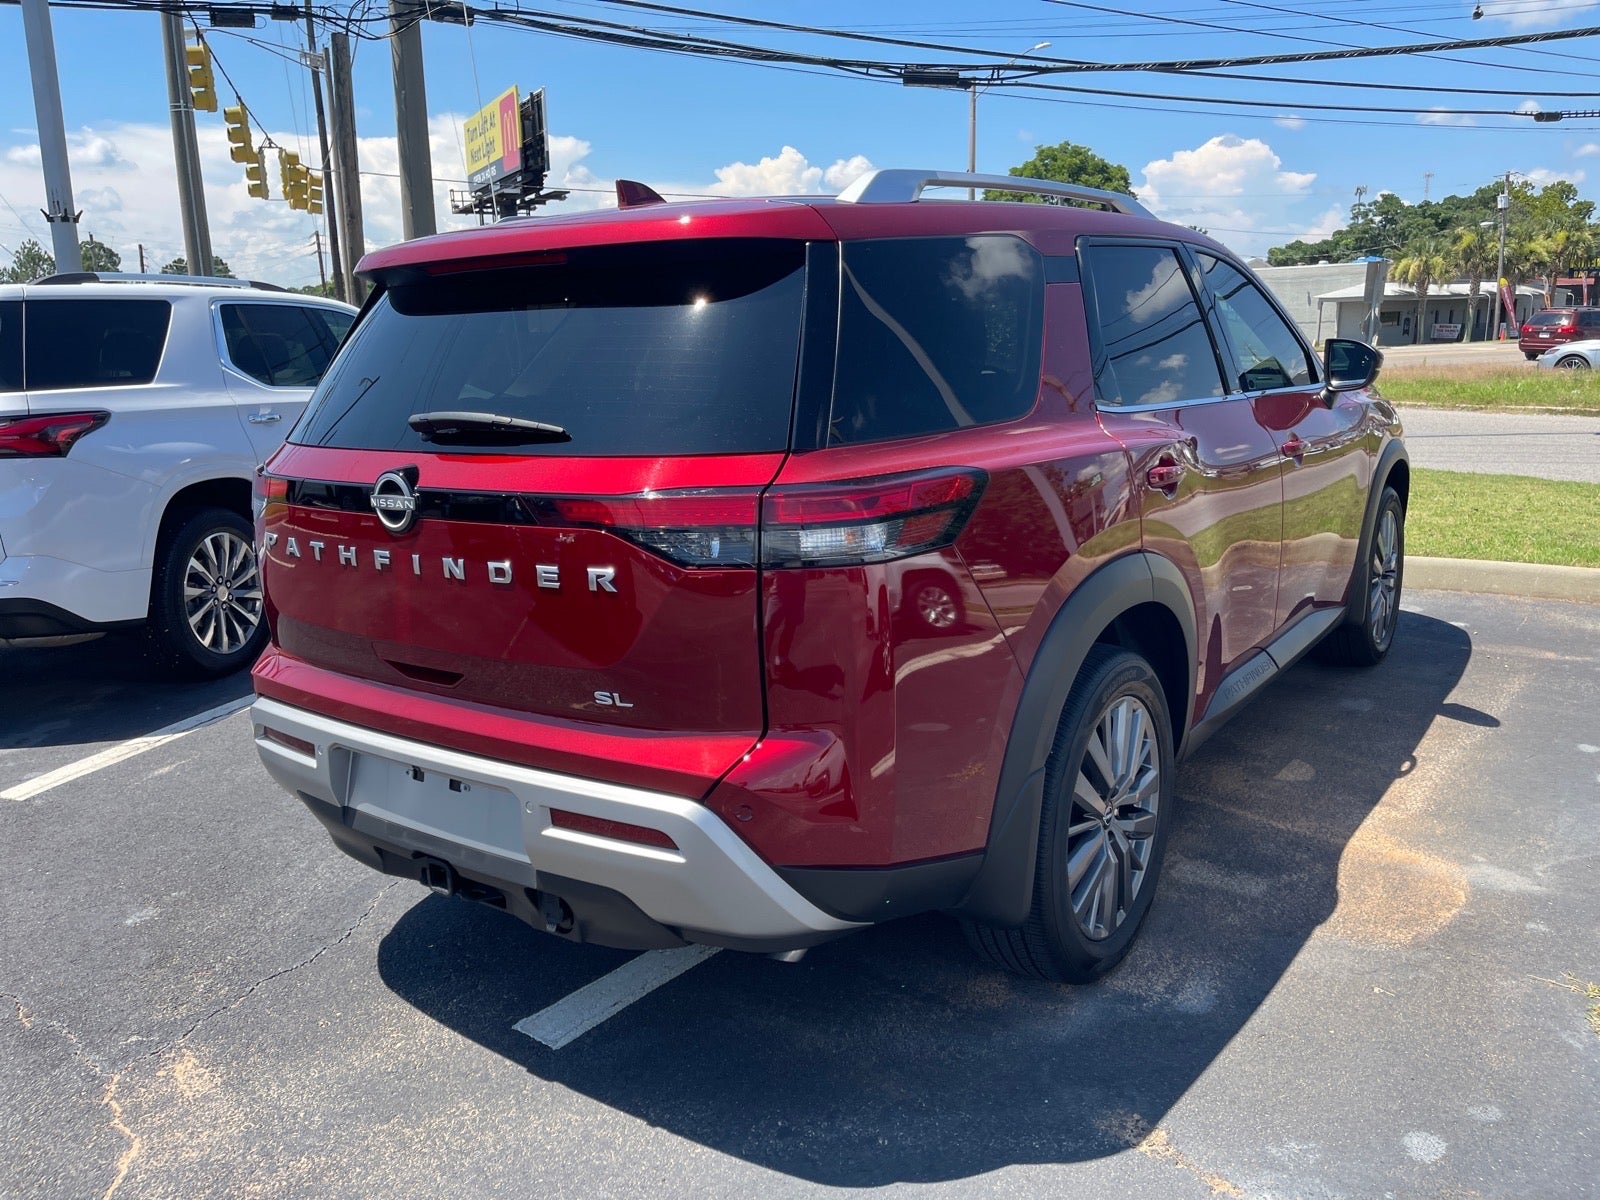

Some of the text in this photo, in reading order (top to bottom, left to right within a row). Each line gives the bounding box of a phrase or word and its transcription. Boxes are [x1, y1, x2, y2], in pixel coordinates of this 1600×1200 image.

[467, 126, 478, 144] Turn
[489, 111, 496, 130] At
[470, 144, 482, 165] Next
[371, 497, 415, 510] NISSAN
[264, 531, 618, 593] PATHFINDER
[1224, 660, 1274, 699] PATHFINDER
[593, 690, 634, 708] SL
